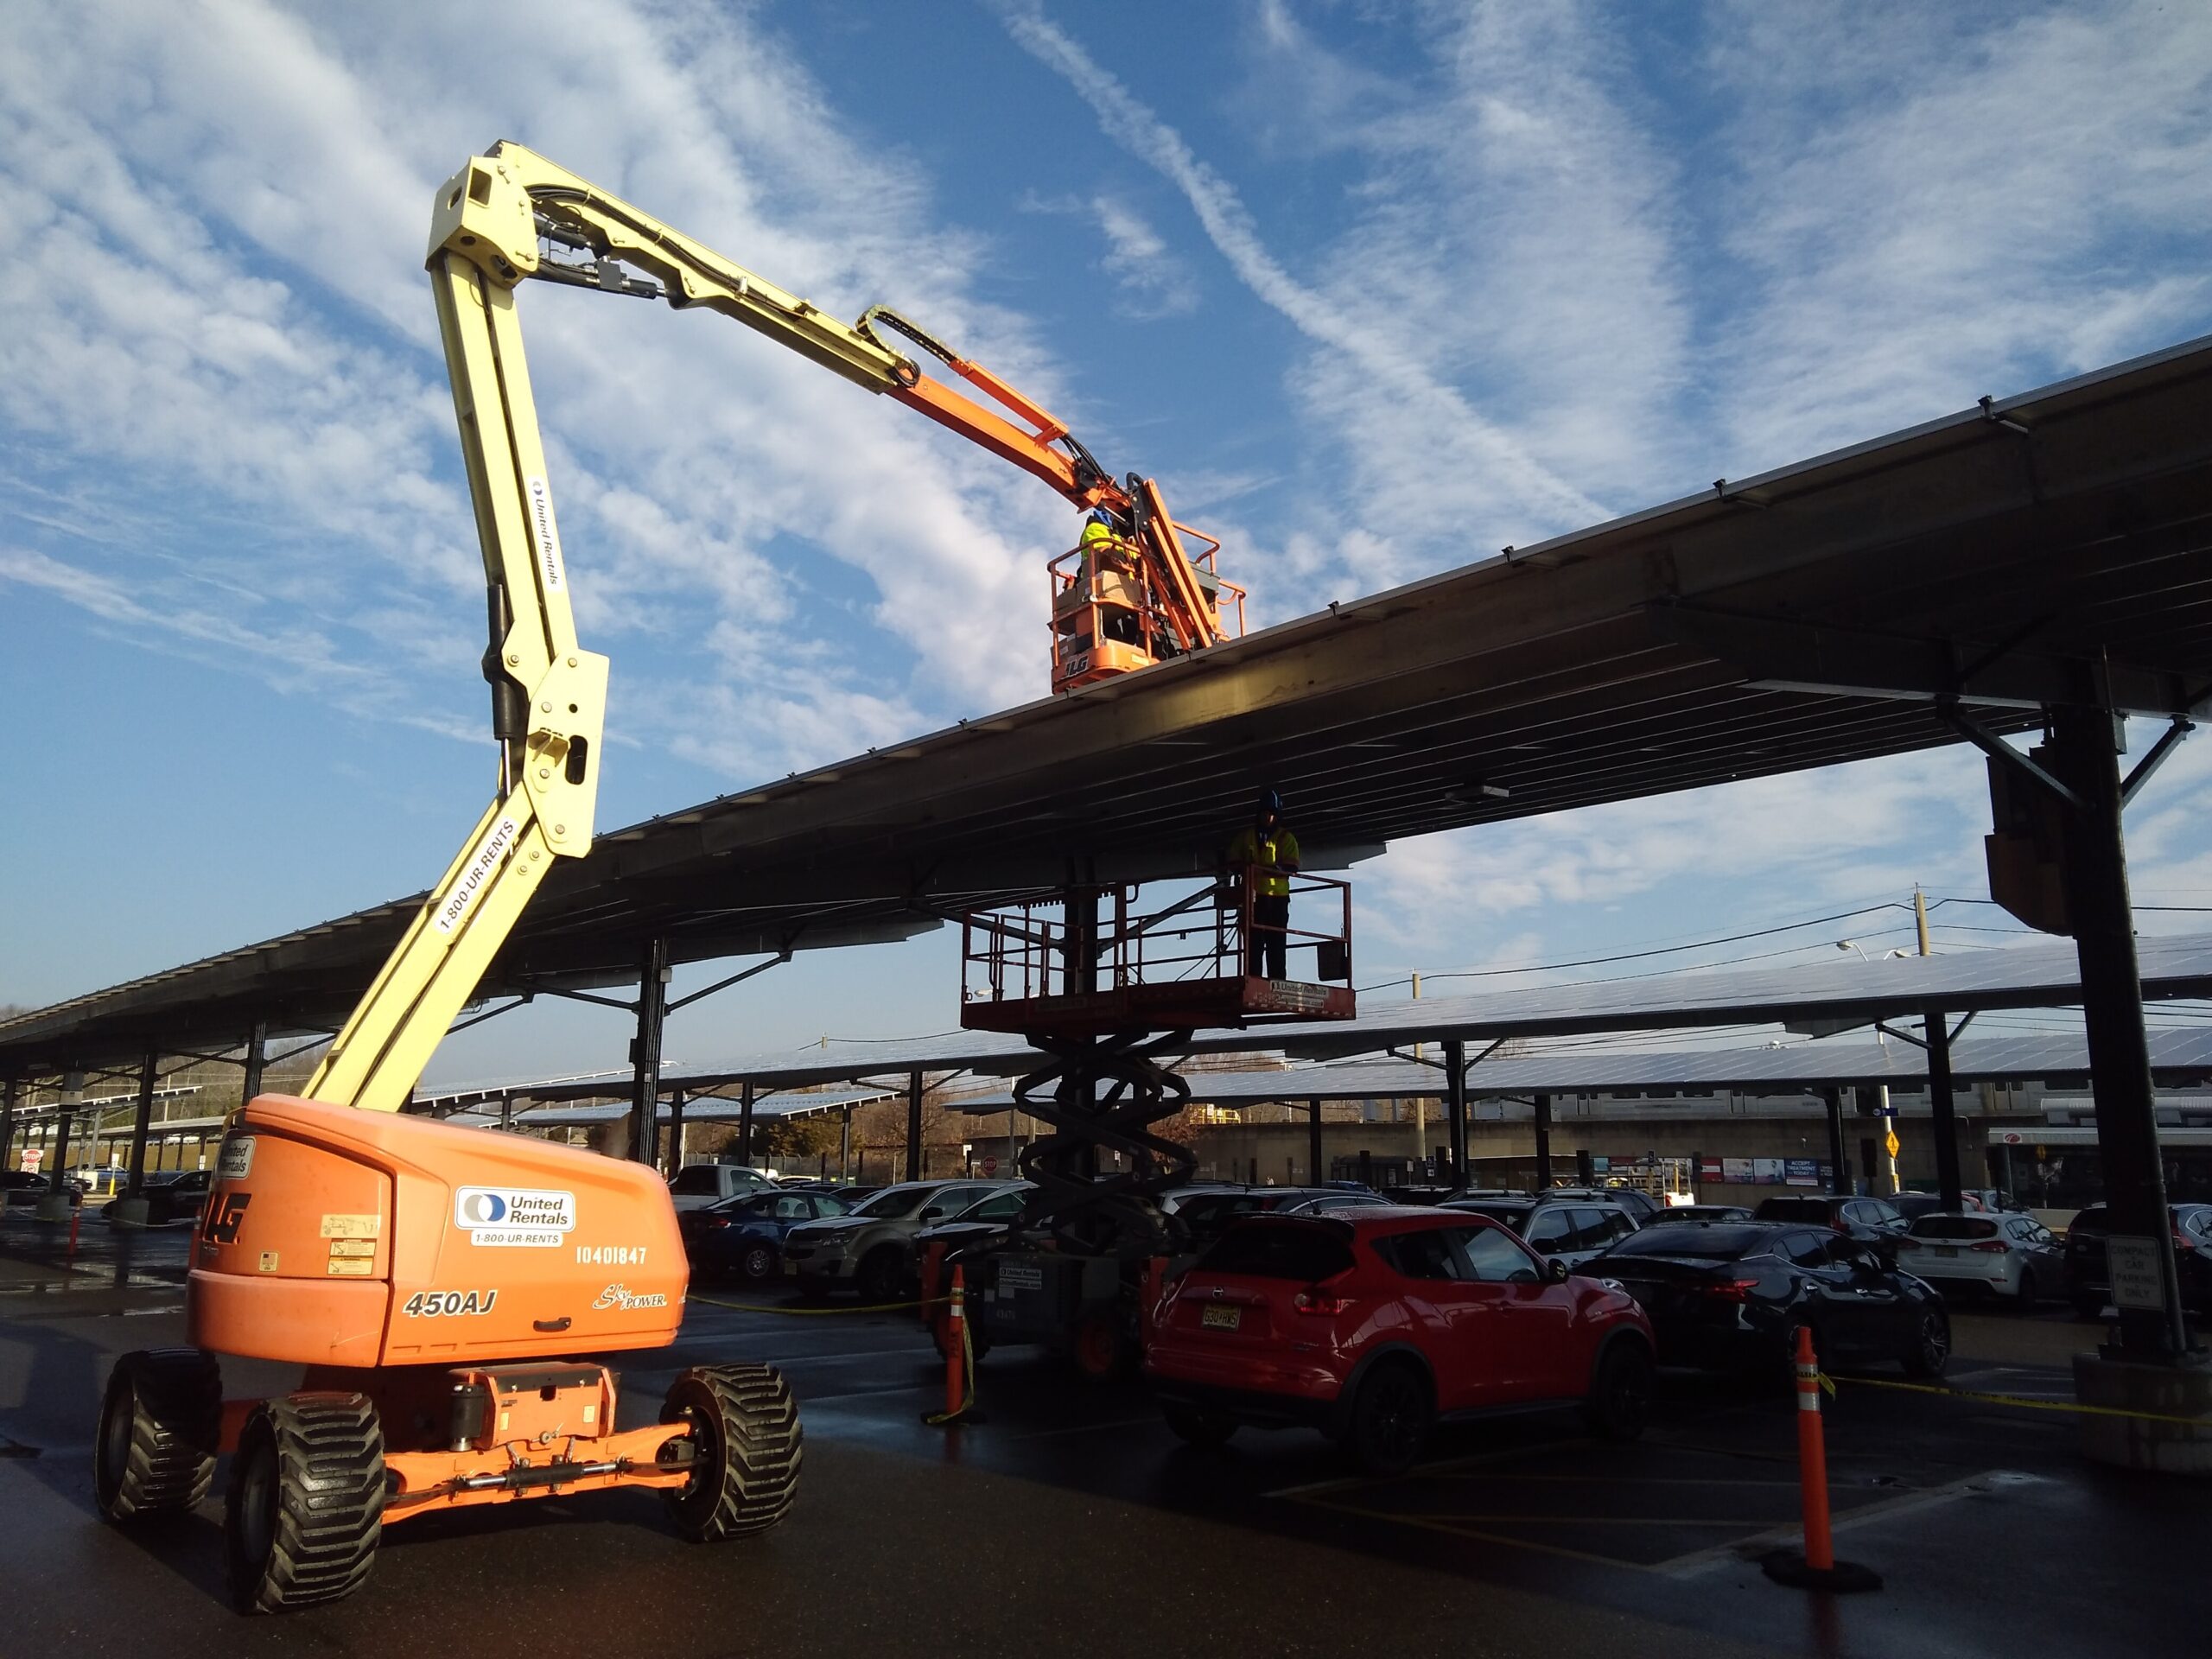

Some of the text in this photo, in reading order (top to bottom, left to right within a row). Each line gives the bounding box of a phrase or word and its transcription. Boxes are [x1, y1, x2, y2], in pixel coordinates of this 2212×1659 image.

[536, 499, 558, 585] United Rentals
[440, 821, 514, 930] 1-800-UR-RENTS
[511, 1196, 564, 1211] United
[510, 1211, 569, 1225] Rentals
[476, 1234, 559, 1243] 1-800-UR-RENTS
[576, 1246, 646, 1264] 10401847
[2111, 1245, 2155, 1256] COMPACT
[2126, 1260, 2145, 1270] CAR
[2115, 1273, 2158, 1285] PARKING
[2126, 1287, 2150, 1298] ONLY
[403, 1290, 498, 1317] 450AJ
